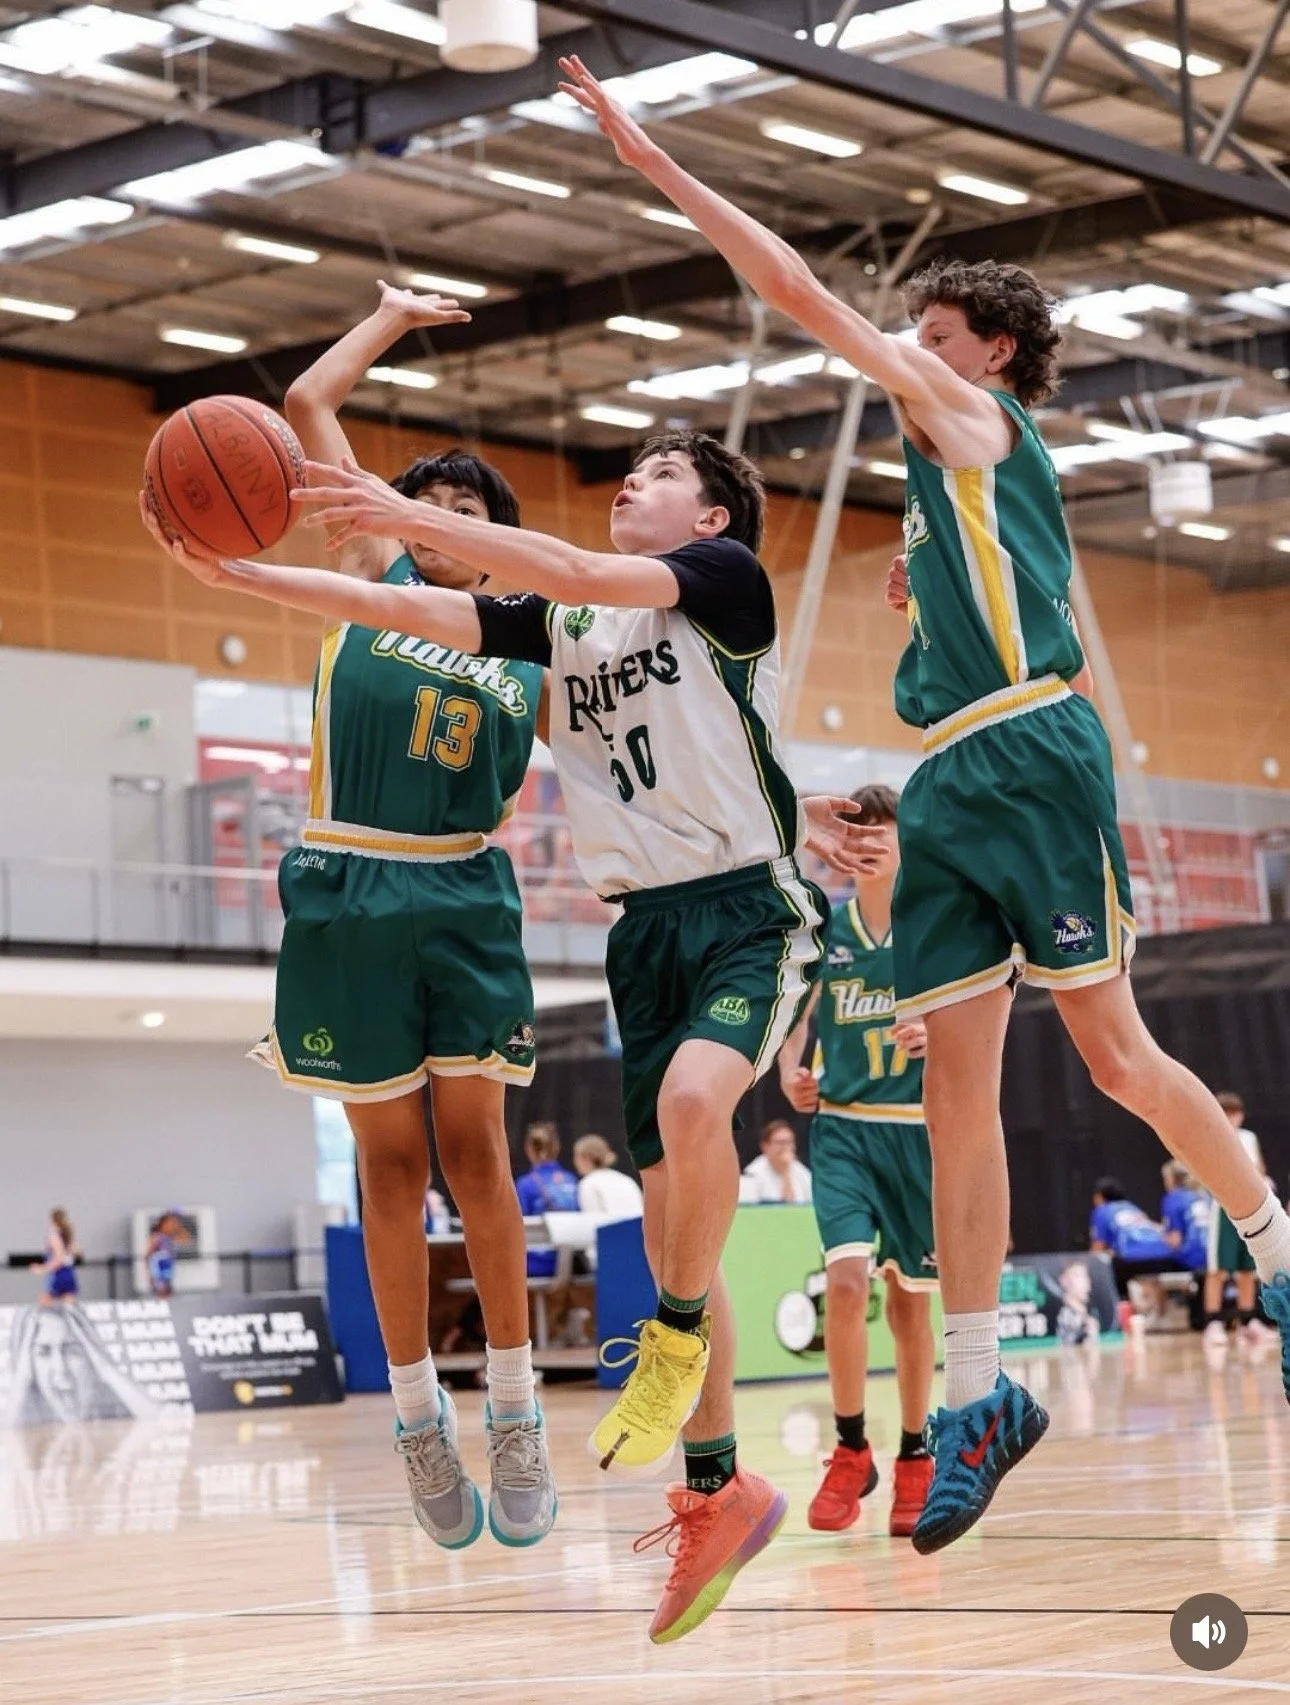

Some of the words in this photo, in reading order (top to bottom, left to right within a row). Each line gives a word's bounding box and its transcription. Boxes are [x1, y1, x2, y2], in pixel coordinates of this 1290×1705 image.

[371, 629, 528, 717] Hawks
[408, 685, 482, 772] 13
[1052, 924, 1094, 945] Hawks
[295, 1056, 342, 1071] woolworths
[863, 1027, 909, 1080] 17
[192, 1315, 267, 1337] DON'T
[269, 1312, 305, 1332] BE
[187, 1333, 254, 1356] THAT
[257, 1329, 319, 1353] MUM
